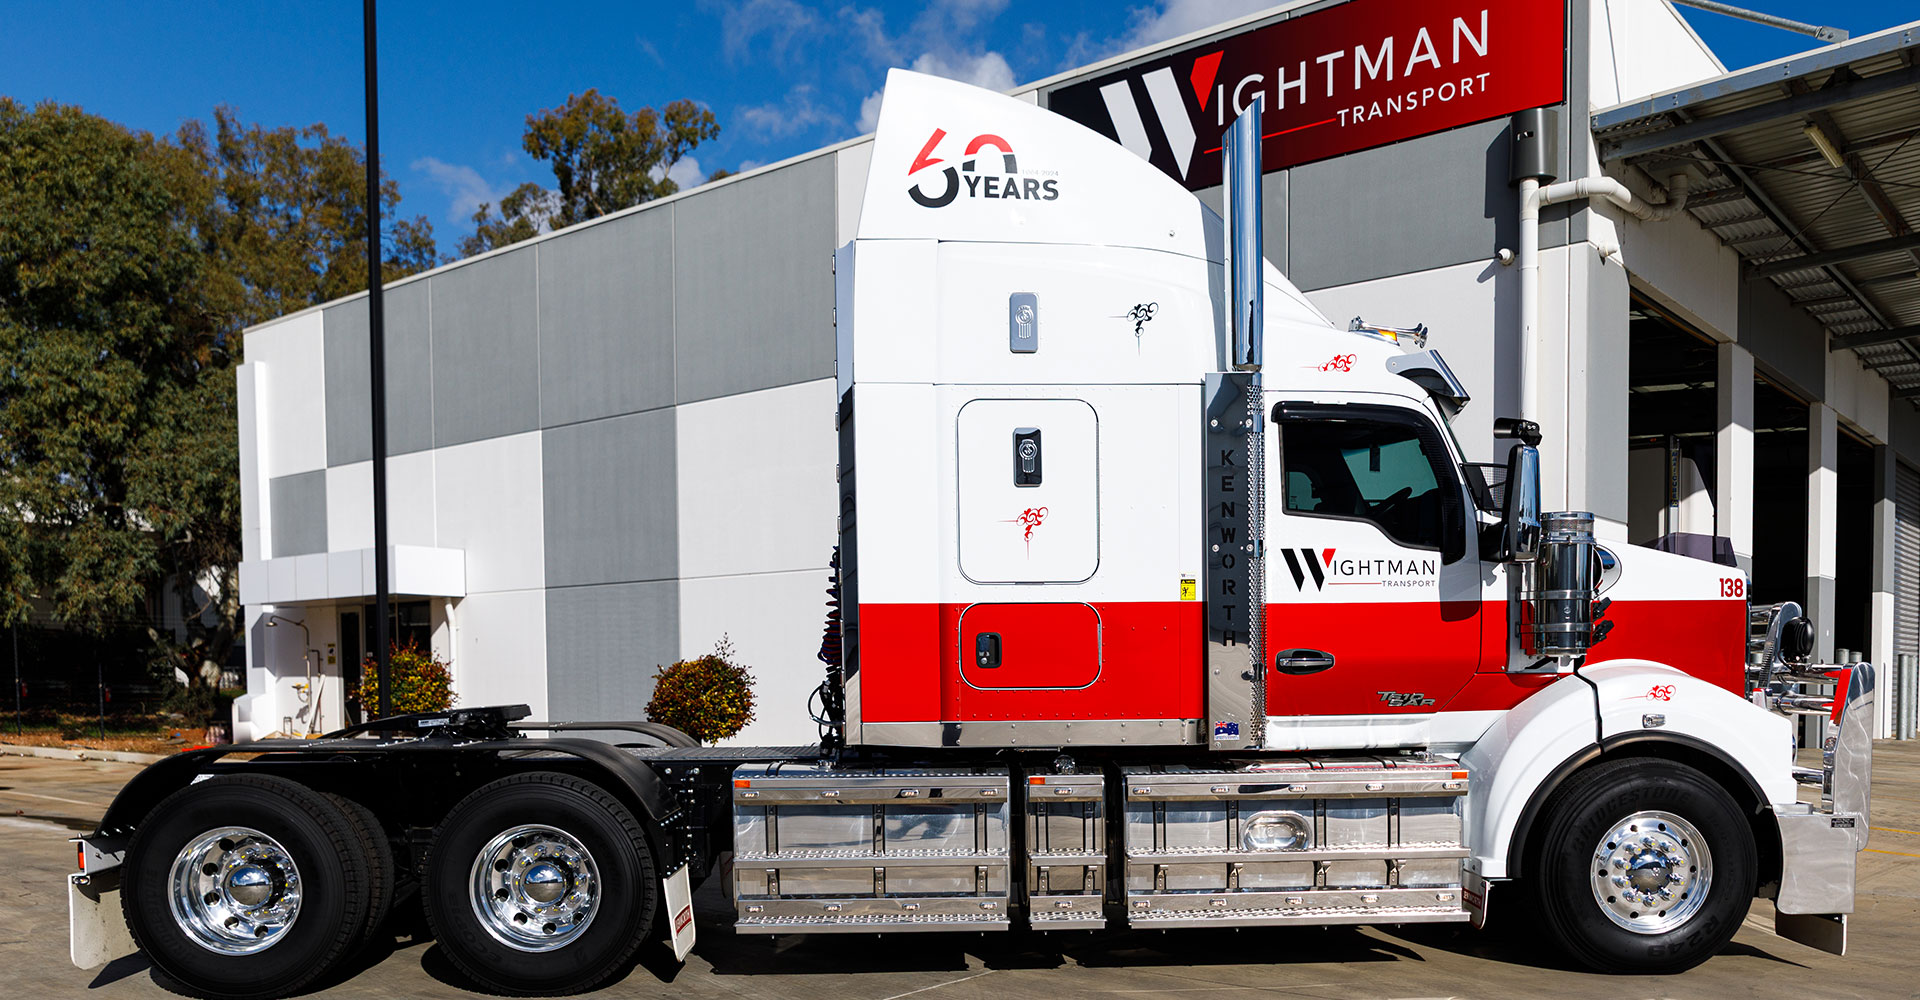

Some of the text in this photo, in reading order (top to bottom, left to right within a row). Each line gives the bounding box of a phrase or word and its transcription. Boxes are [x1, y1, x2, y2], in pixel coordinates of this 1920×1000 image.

[1100, 9, 1488, 181] WIGHTMAN
[1336, 72, 1490, 127] TRANSPORT
[907, 127, 1018, 208] 60
[963, 174, 1059, 201] YEARS
[1220, 449, 1236, 647] KENWORTH
[1280, 548, 1435, 592] WIGHTMAN
[1381, 580, 1436, 588] TRANSPORT
[1719, 577, 1744, 598] 138
